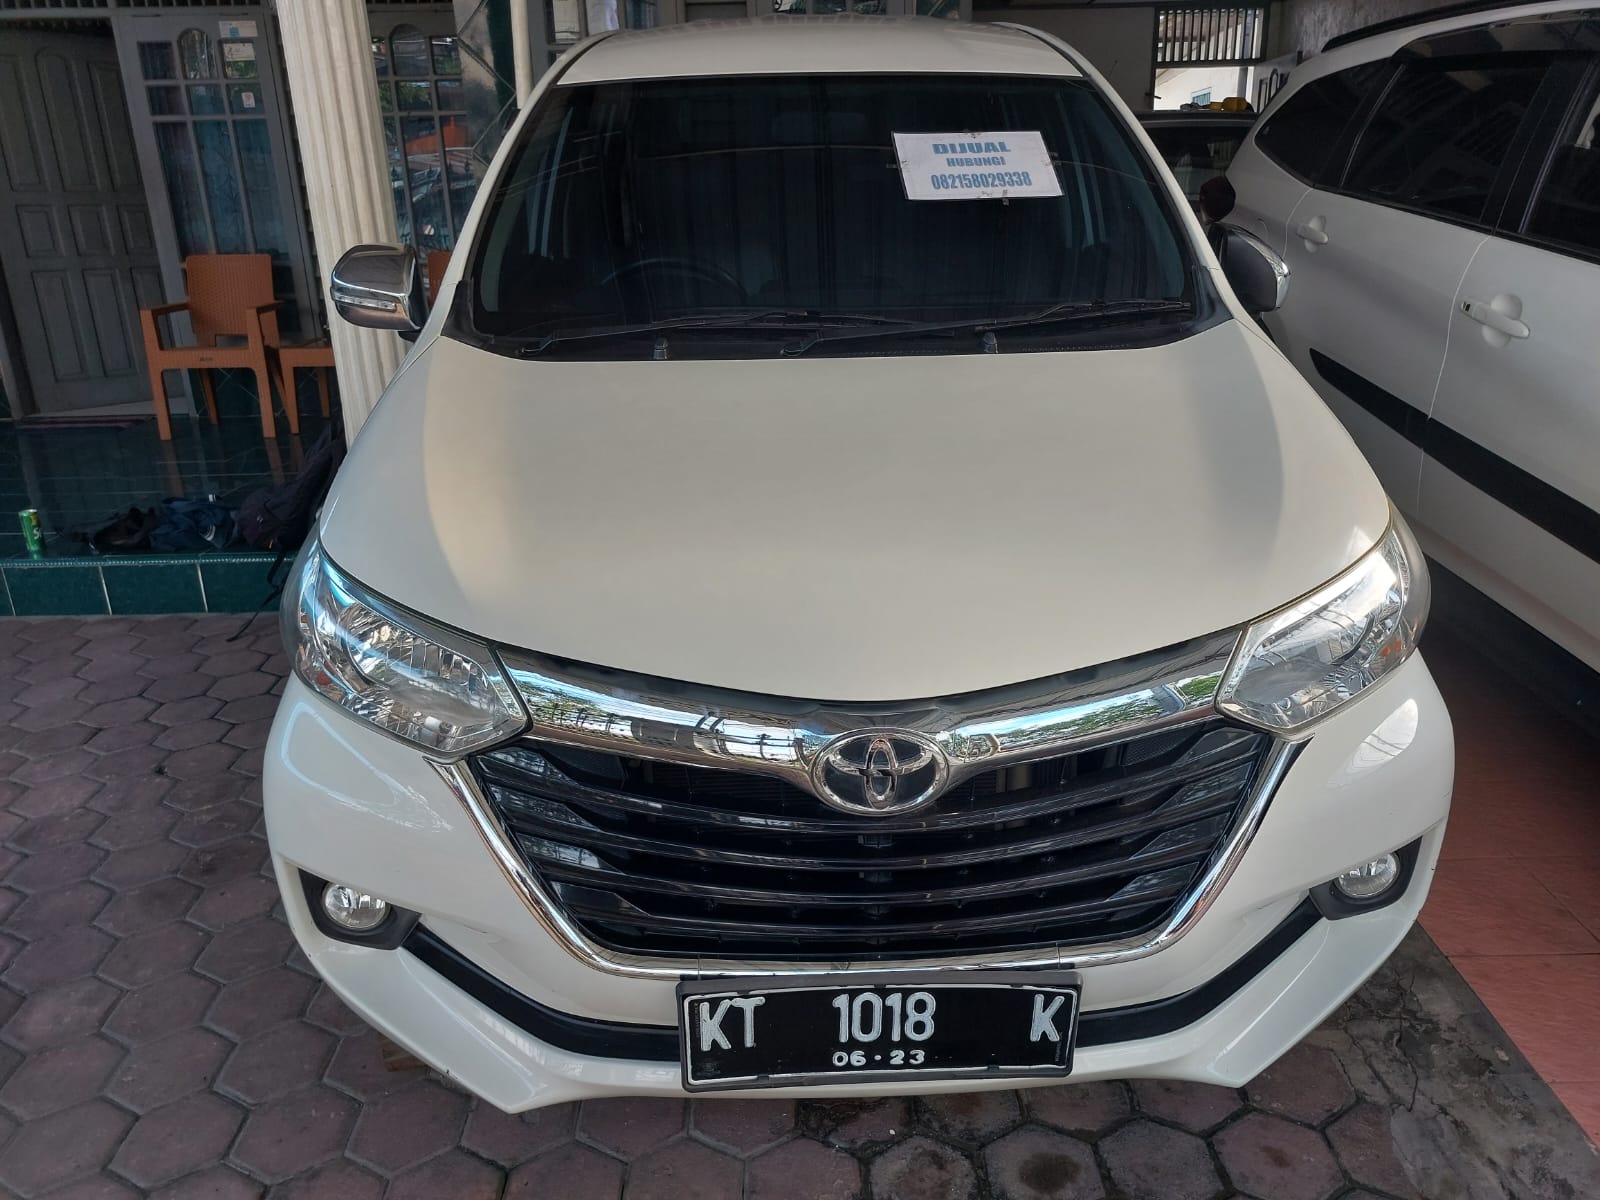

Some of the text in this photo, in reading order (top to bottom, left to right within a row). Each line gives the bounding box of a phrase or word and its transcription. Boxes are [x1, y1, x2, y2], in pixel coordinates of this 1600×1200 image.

[932, 142, 1011, 154] DIJUAL
[946, 156, 1006, 167] HUBUNGI
[931, 171, 1032, 189] 082158029338
[700, 996, 766, 1052] KT
[832, 991, 936, 1042] 1018
[1030, 993, 1065, 1042] K
